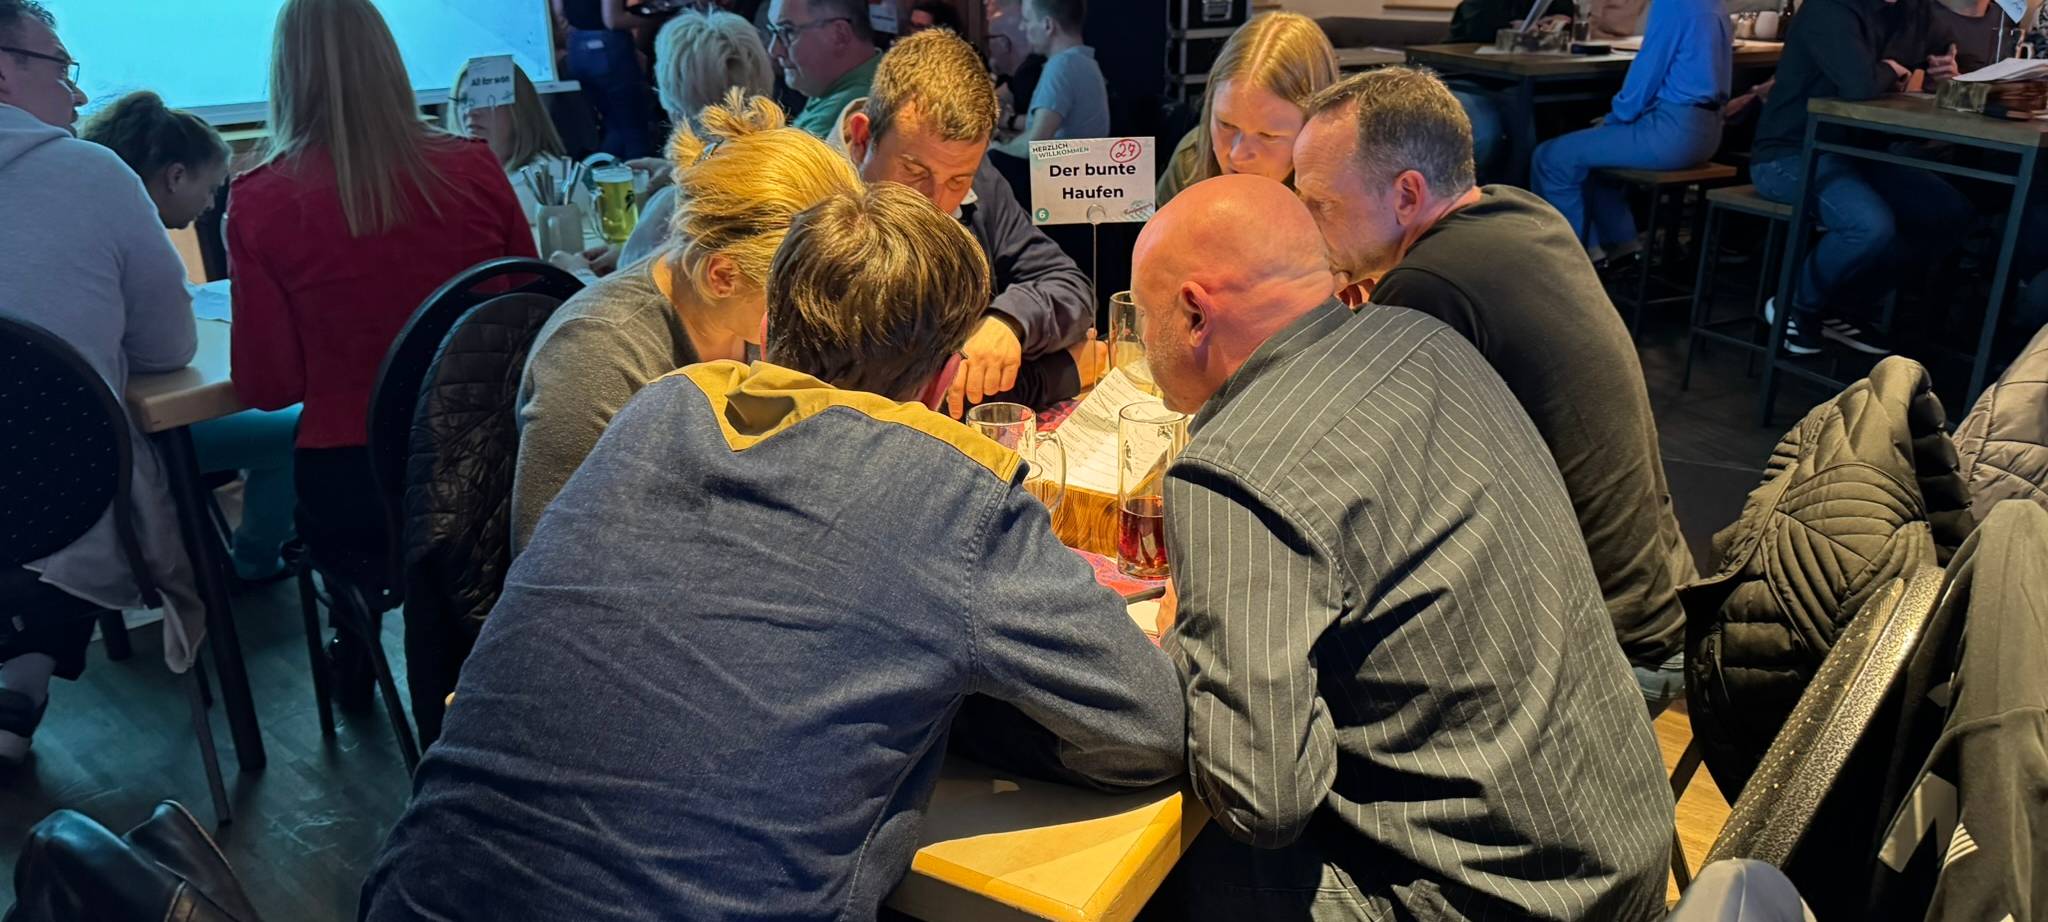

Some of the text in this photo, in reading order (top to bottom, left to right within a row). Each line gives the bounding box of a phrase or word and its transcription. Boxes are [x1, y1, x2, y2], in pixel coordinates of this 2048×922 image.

[1032, 143, 1068, 153] HERZLICH
[1038, 146, 1089, 158] WILLKOMMEN
[1049, 163, 1136, 177] Der bunte
[1062, 185, 1124, 200] Haufen
[1038, 211, 1046, 219] 6
